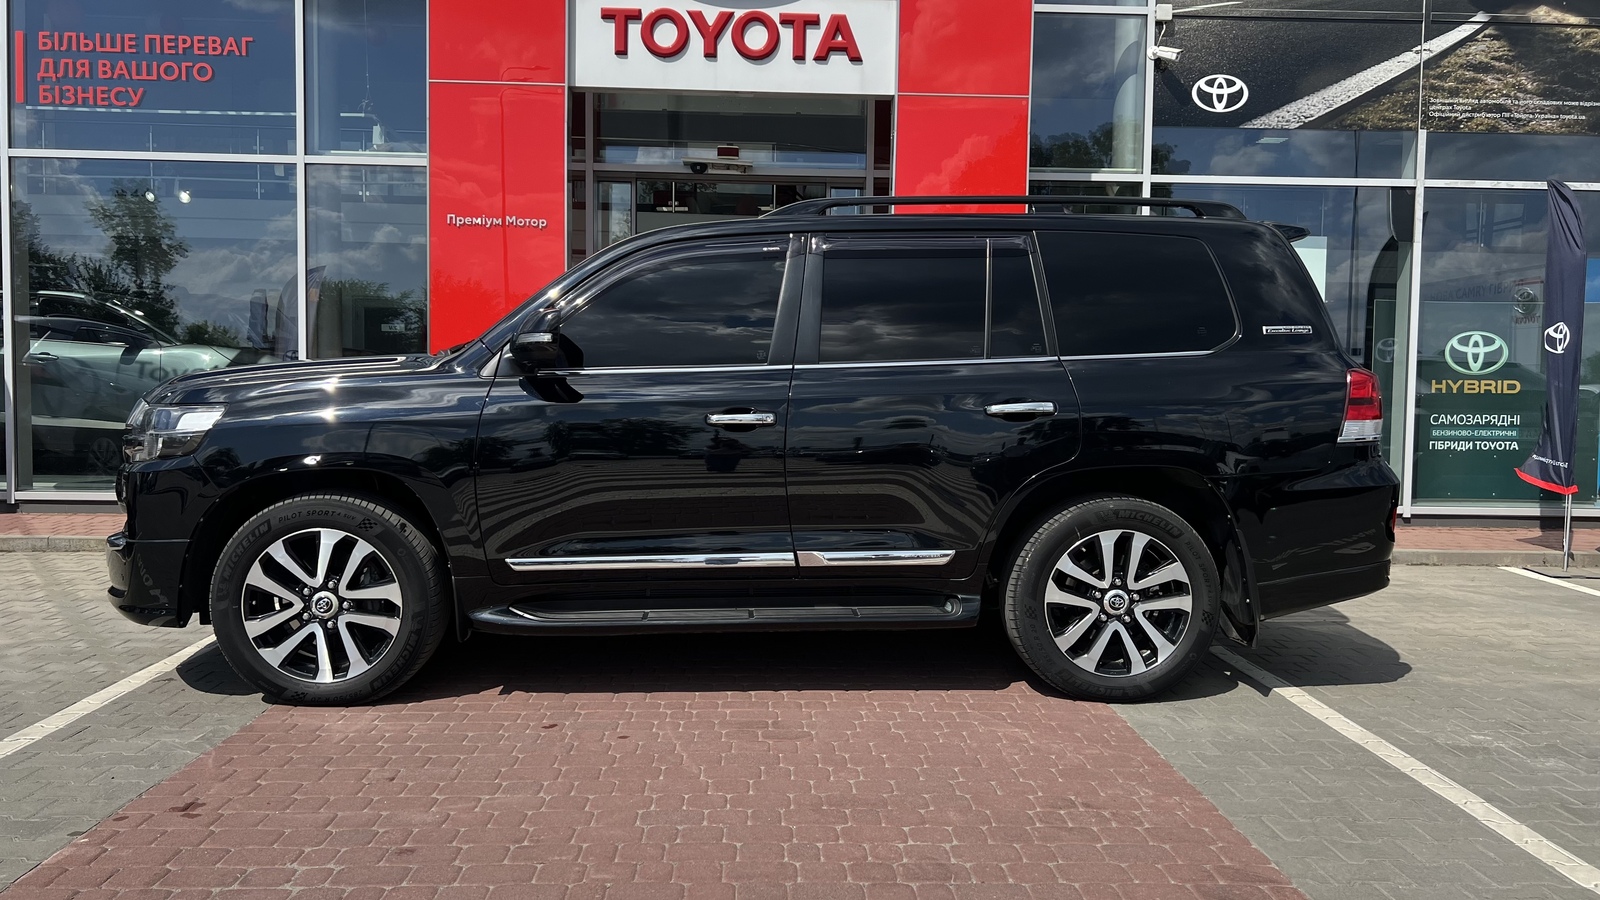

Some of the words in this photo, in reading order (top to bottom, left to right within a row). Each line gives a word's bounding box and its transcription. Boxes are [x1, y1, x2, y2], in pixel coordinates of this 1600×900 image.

[38, 31, 136, 53] БІЛЬШЕ
[144, 35, 254, 56] ПЕРЕВАГ
[601, 7, 863, 61] TOYOTA
[37, 58, 90, 81] ДЛЯ
[98, 60, 213, 82] ВАШОГО
[39, 85, 144, 107] БІЗНЕСУ
[446, 214, 502, 228] Преміум
[505, 215, 547, 229] Мотор
[1431, 380, 1521, 394] HYBRID
[1430, 414, 1521, 426] САМОЗАРЯДНІ
[1432, 429, 1517, 437] БЕНЗИНОВО-ЕЛЕКТРИЧНІ
[1429, 441, 1473, 451] ГІБРИДИ
[1475, 441, 1519, 451] TOYOTA
[223, 522, 270, 579] MICHELIN
[278, 511, 303, 524] PILOT
[306, 509, 337, 518] SPORT
[1117, 510, 1182, 537] MICHELIN
[1184, 541, 1202, 561] PILOT
[1199, 563, 1212, 588] SPORT
[373, 634, 419, 691] MICHELIN
